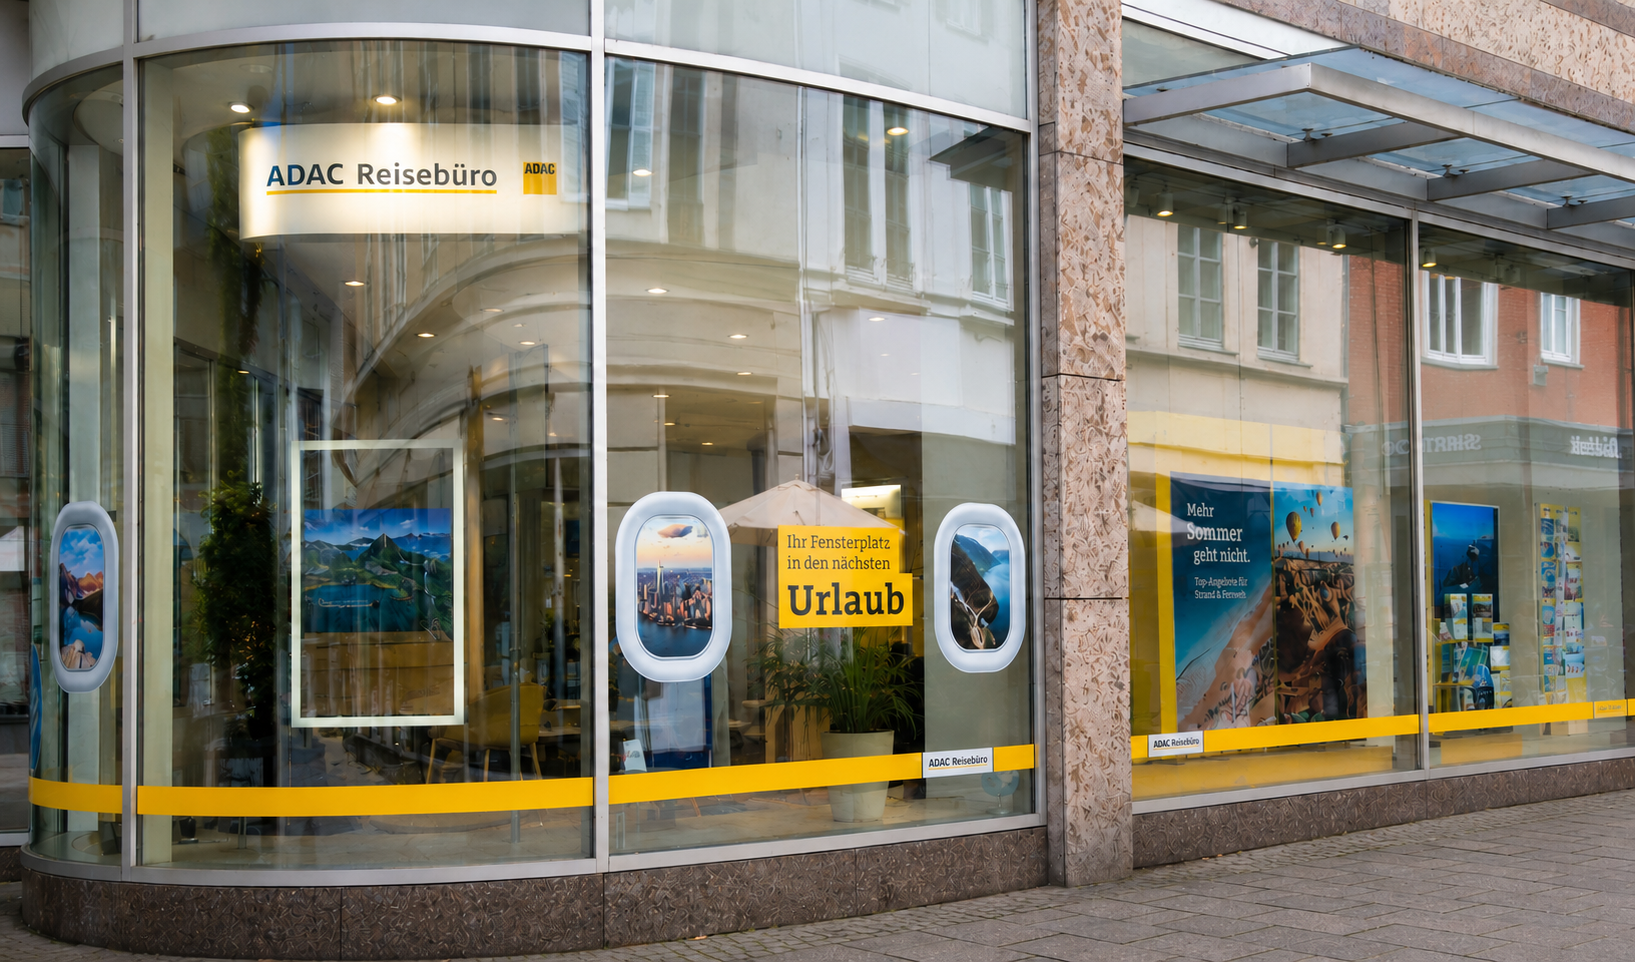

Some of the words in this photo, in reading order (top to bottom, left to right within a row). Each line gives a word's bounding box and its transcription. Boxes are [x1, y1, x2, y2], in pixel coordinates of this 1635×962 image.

[266, 163, 344, 186] ADAC
[357, 162, 497, 186] Reisebüro
[524, 162, 556, 175] ADAC
[1187, 502, 1214, 517] Mehr
[1187, 522, 1243, 542] Sommer
[787, 534, 807, 549] Ihr
[811, 535, 890, 552] Fensterplatz
[787, 555, 801, 570] in
[804, 555, 829, 570] den
[832, 556, 891, 570] nächsten
[1193, 547, 1218, 565] geht
[1220, 547, 1250, 563] nicht.
[787, 582, 905, 616] Urlaub
[1153, 739, 1170, 748] ADAC
[1171, 737, 1199, 747] Reisebüro
[928, 757, 950, 768] ADAC
[952, 755, 988, 766] Reisebüro
